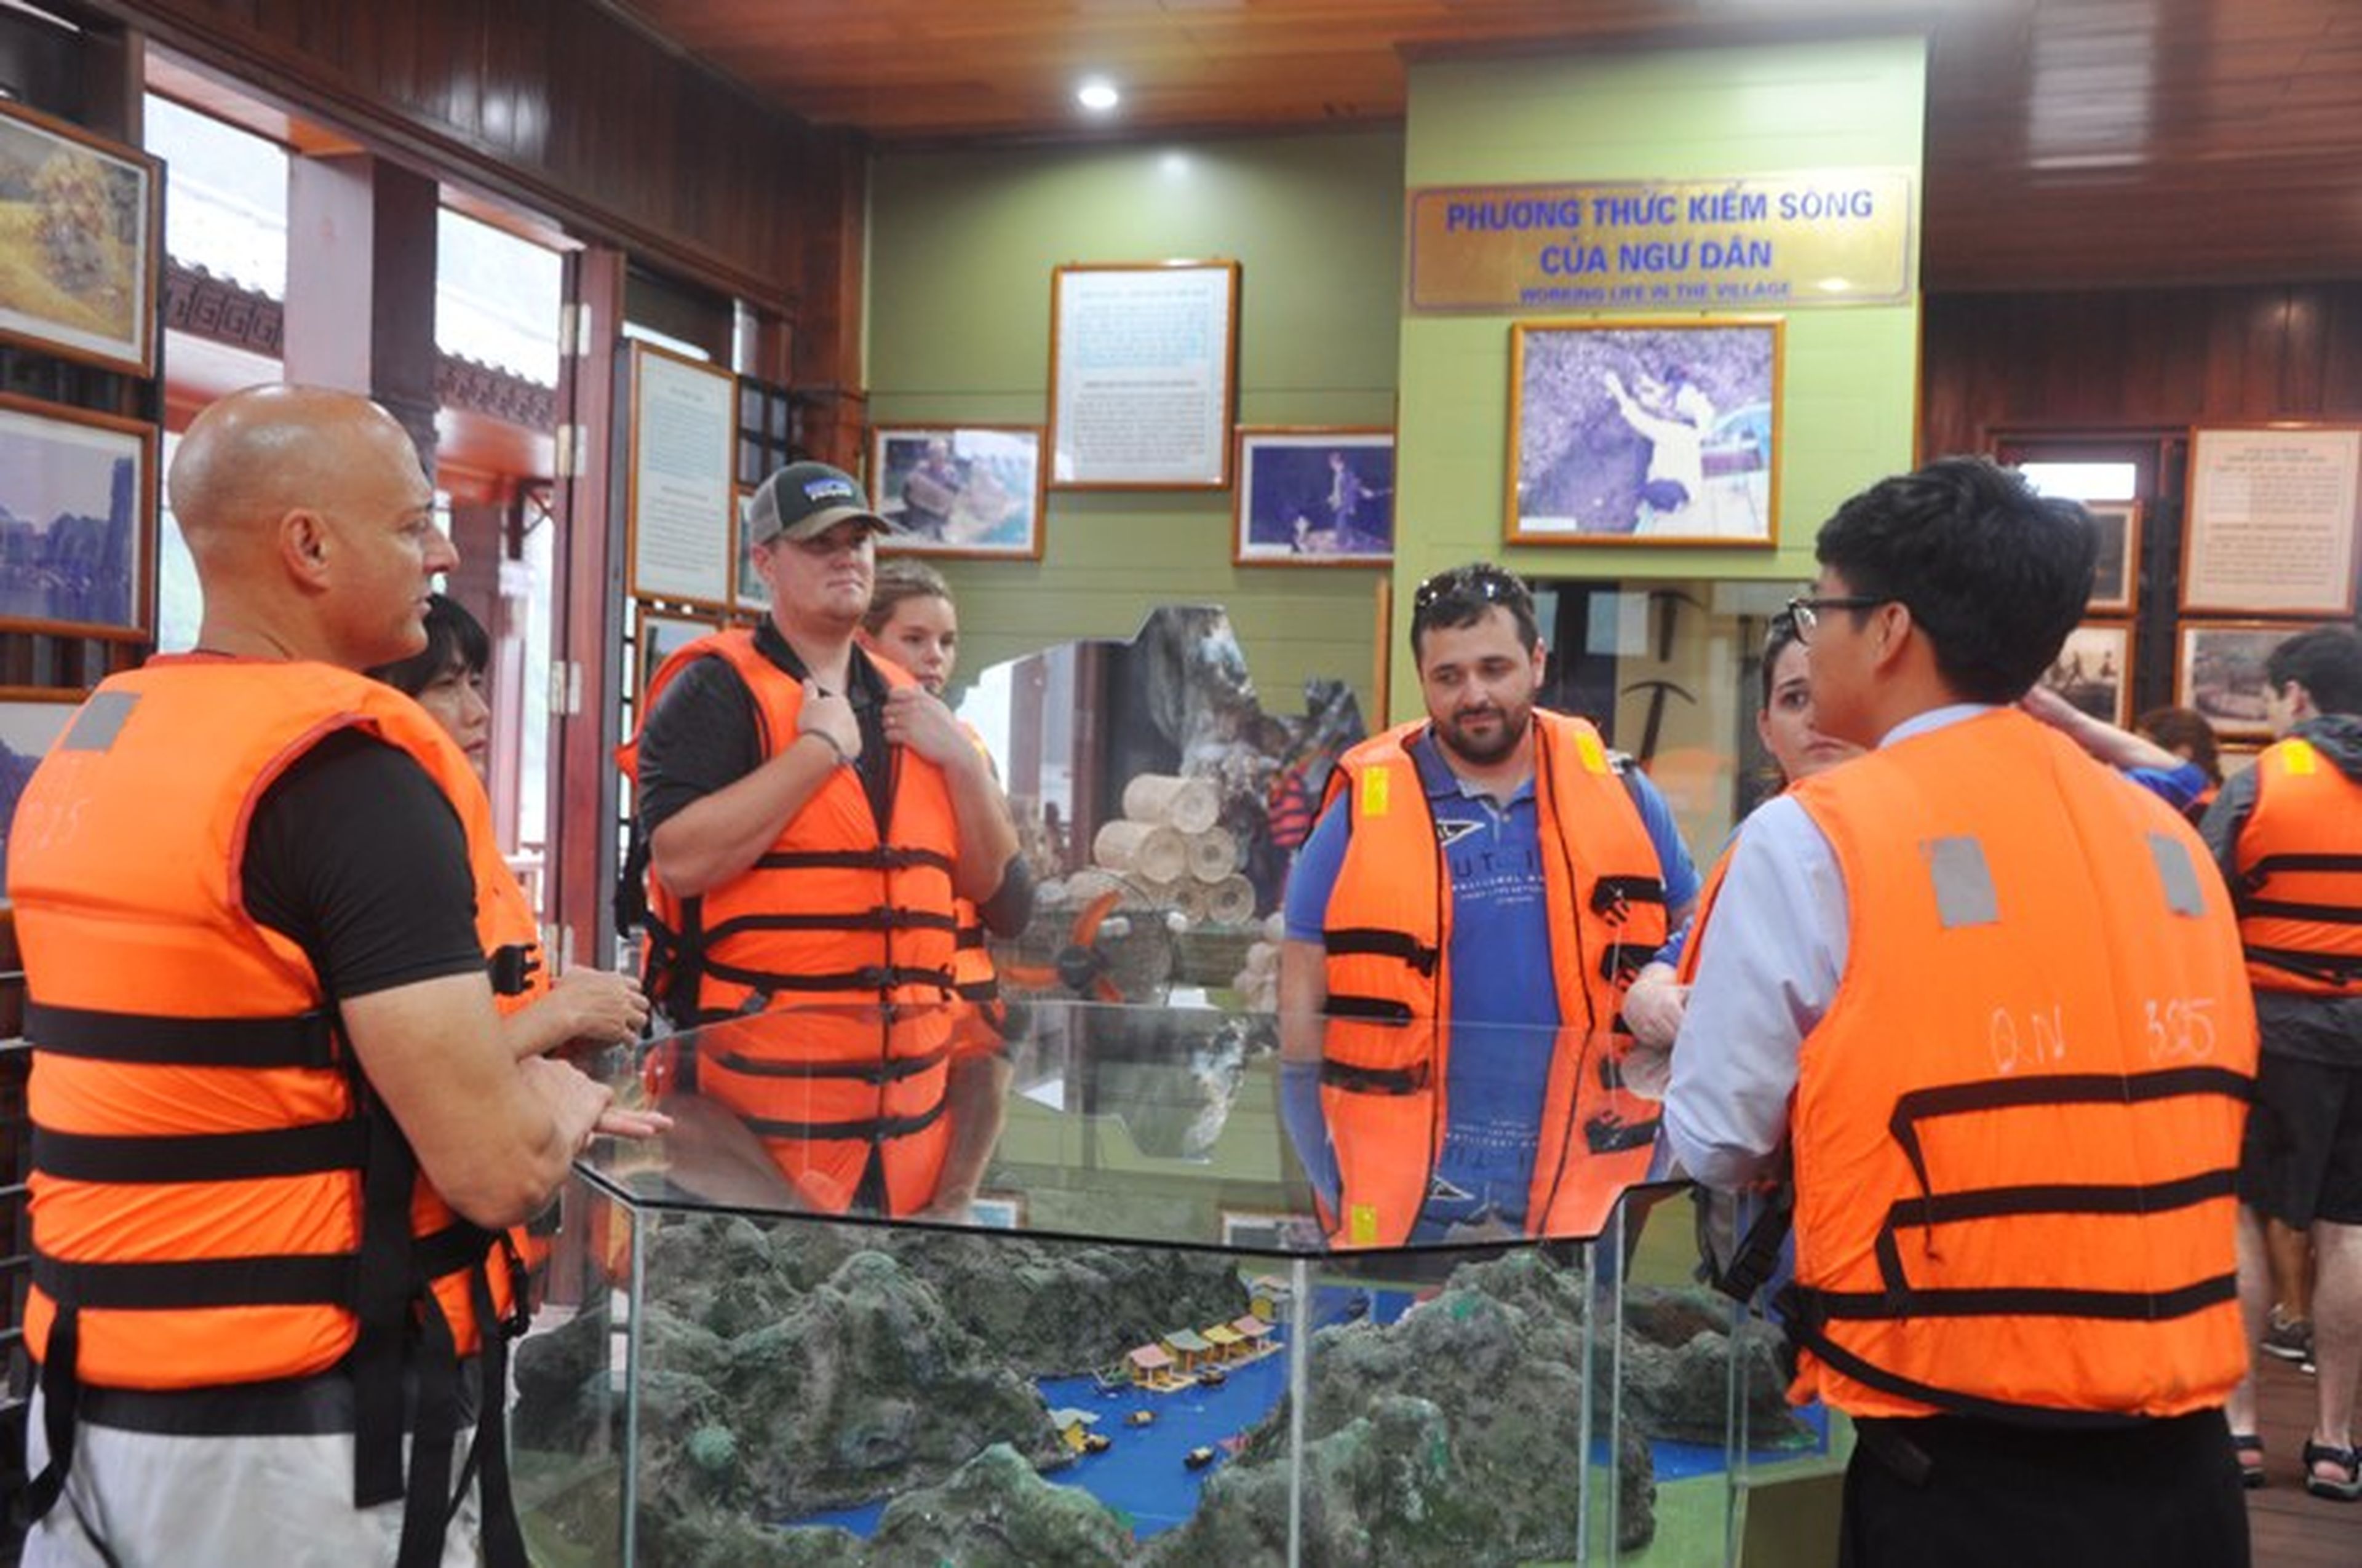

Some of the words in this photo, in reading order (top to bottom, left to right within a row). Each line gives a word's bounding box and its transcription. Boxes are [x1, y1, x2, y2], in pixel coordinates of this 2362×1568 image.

[1521, 286, 1605, 302] WORKING
[1611, 285, 1644, 300] LIFE
[1652, 284, 1669, 298] IN
[1677, 283, 1707, 298] THE
[1718, 281, 1789, 298] VILLAGE
